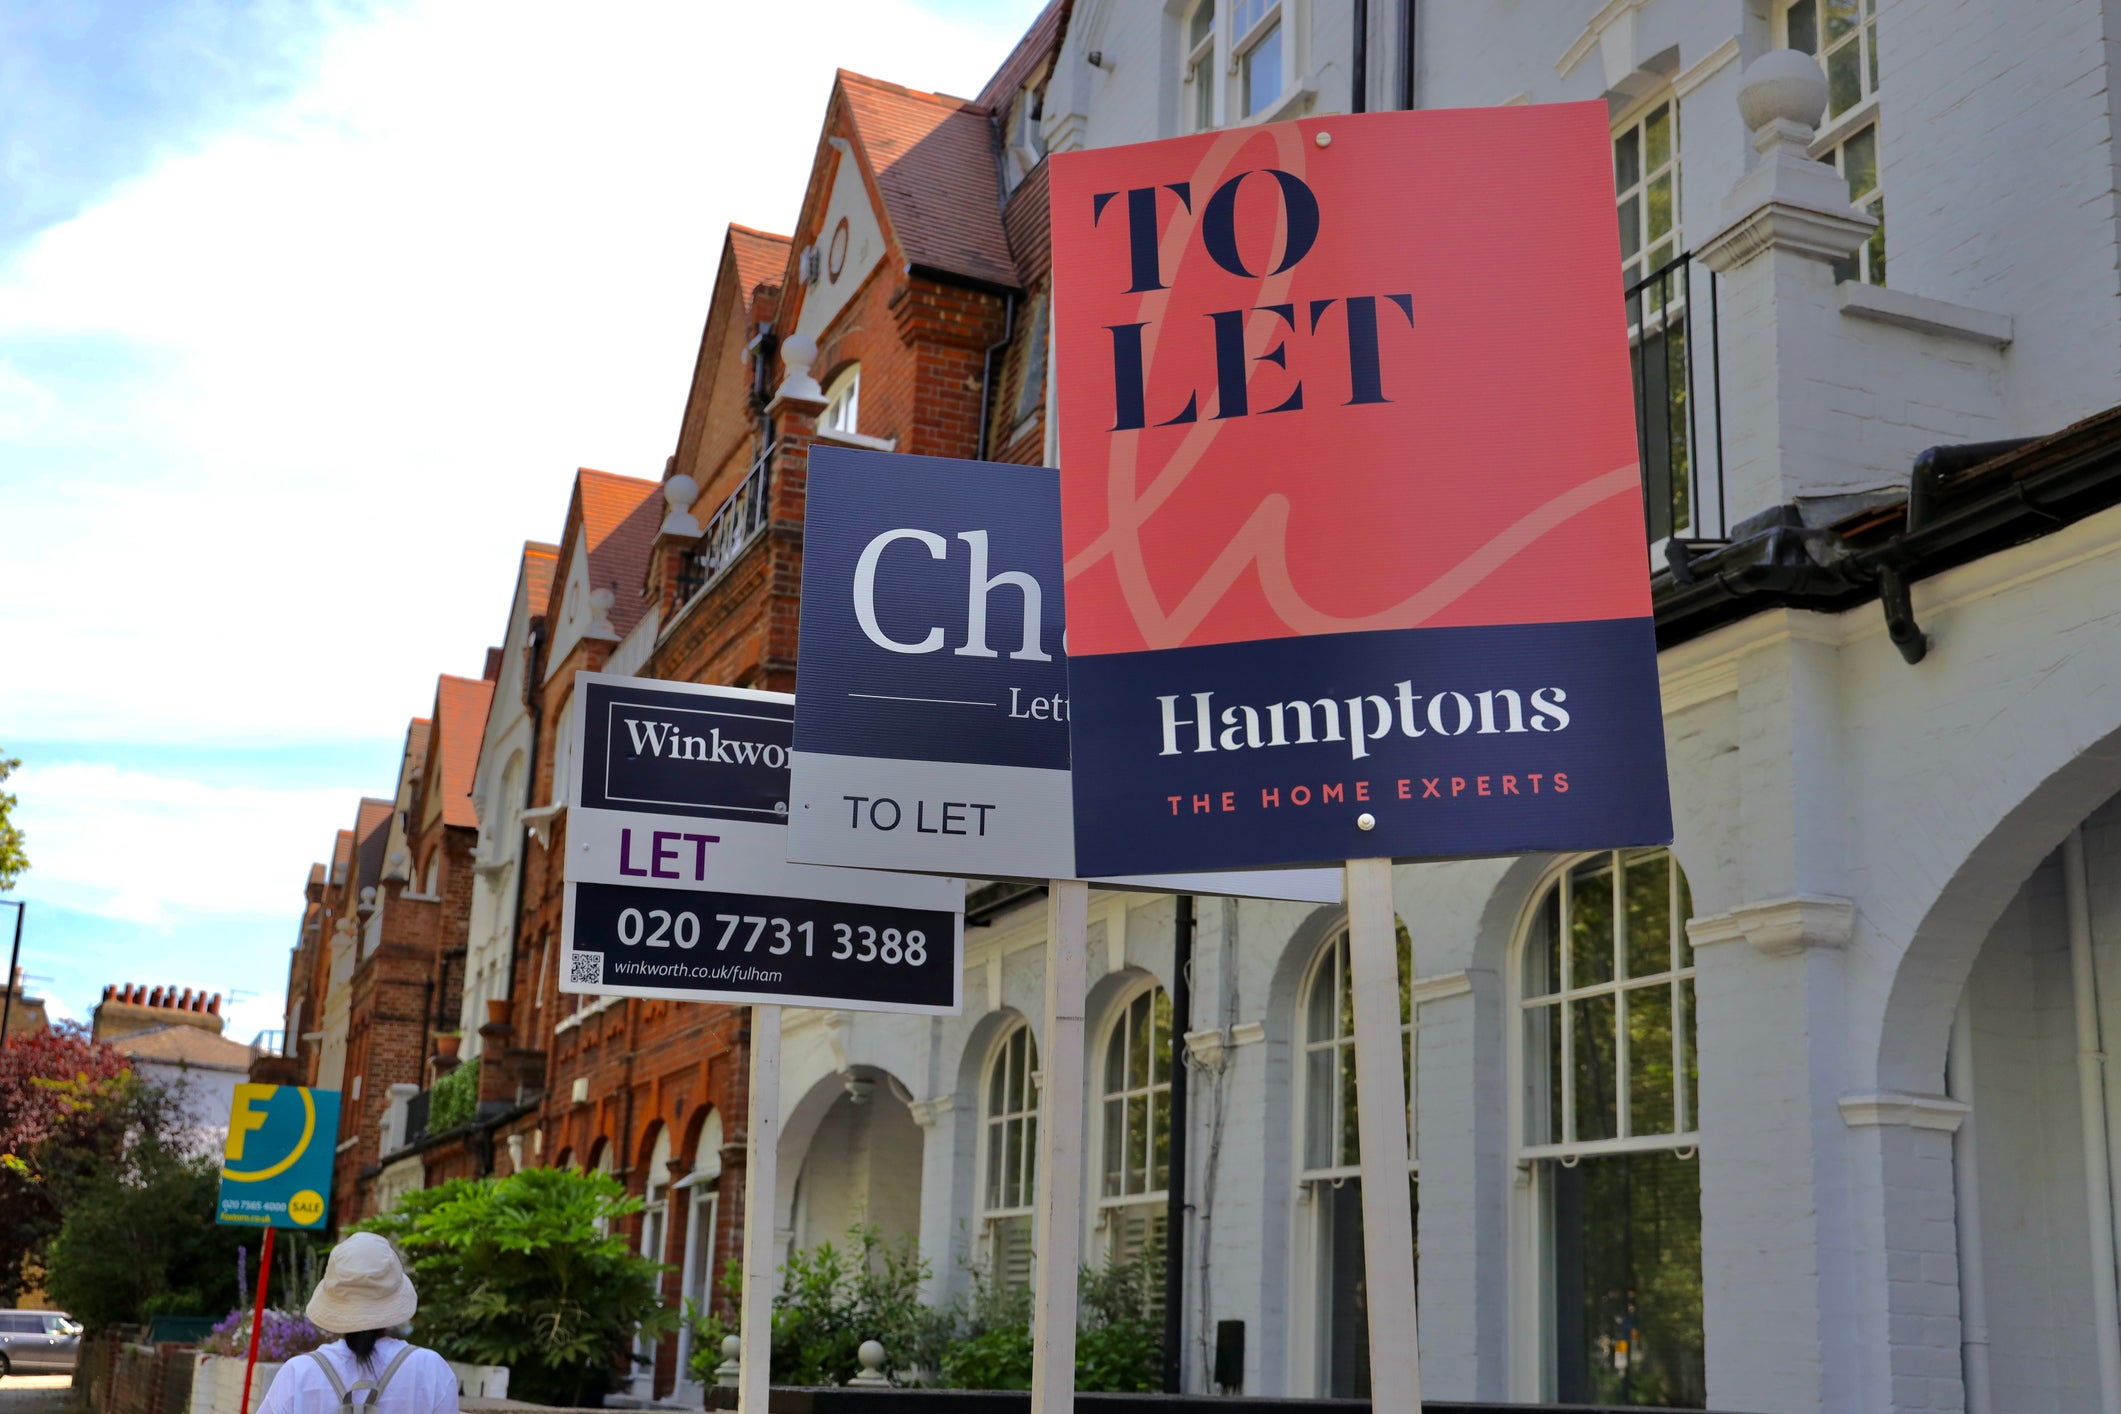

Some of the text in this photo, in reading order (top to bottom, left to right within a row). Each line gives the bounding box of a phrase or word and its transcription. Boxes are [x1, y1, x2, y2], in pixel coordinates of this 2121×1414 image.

[1094, 170, 1319, 293] TO
[1101, 293, 1414, 432] LET
[853, 528, 1069, 662] Ch
[1157, 679, 1570, 760] Hamptons
[843, 796, 996, 837] TO LET
[1168, 773, 1570, 816] THE HOME EXPERTS
[619, 828, 721, 882] LET
[617, 907, 928, 967] 020 7731 3388
[614, 960, 783, 983] winkworth.co.uk/fulham
[292, 1202, 320, 1213] SALE
